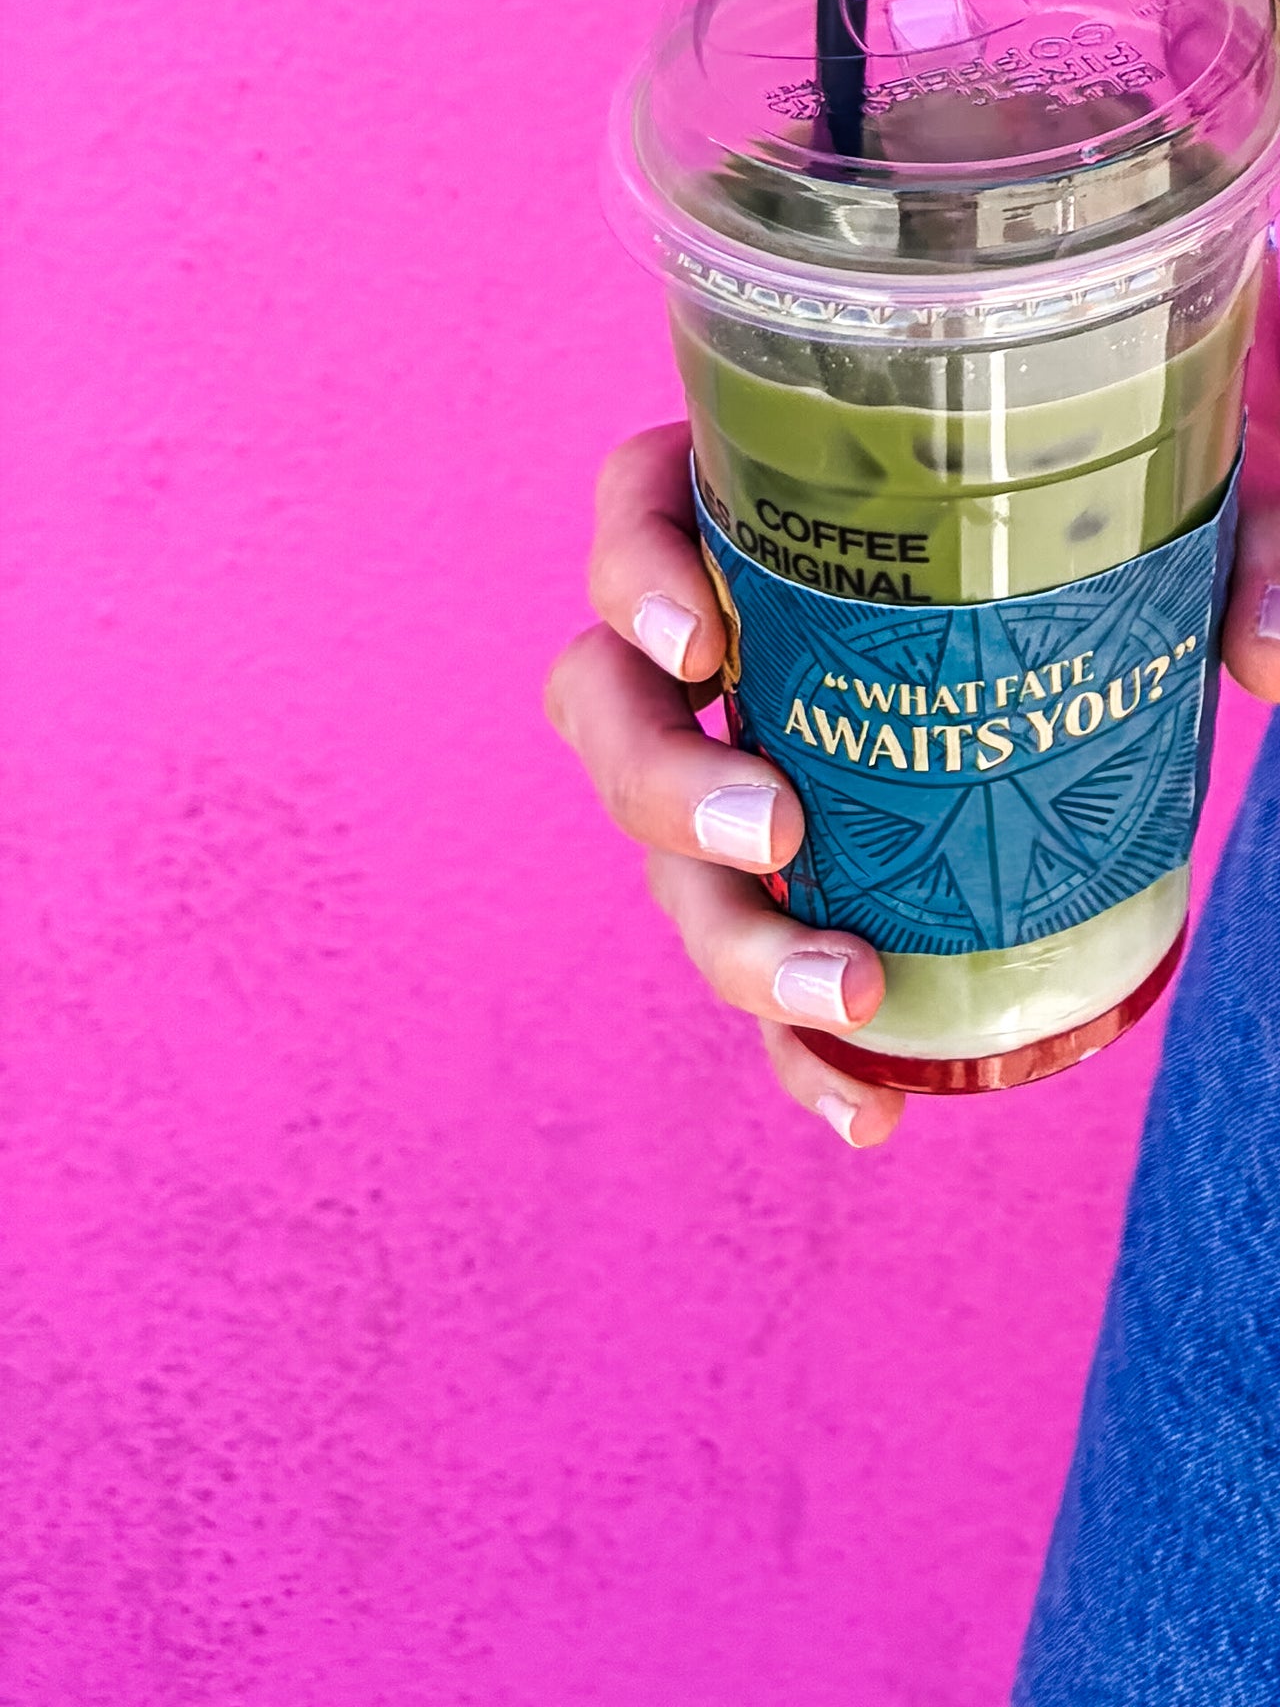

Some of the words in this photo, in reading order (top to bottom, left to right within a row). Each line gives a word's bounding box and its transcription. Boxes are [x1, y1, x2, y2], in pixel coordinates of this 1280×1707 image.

[735, 519, 933, 603] ORIGINAL
[755, 497, 931, 564] COFFEE
[784, 697, 1015, 772] AWAITS
[1024, 635, 1197, 753] YOU?”
[823, 671, 986, 717] “WHAT
[995, 649, 1095, 709] FATE
